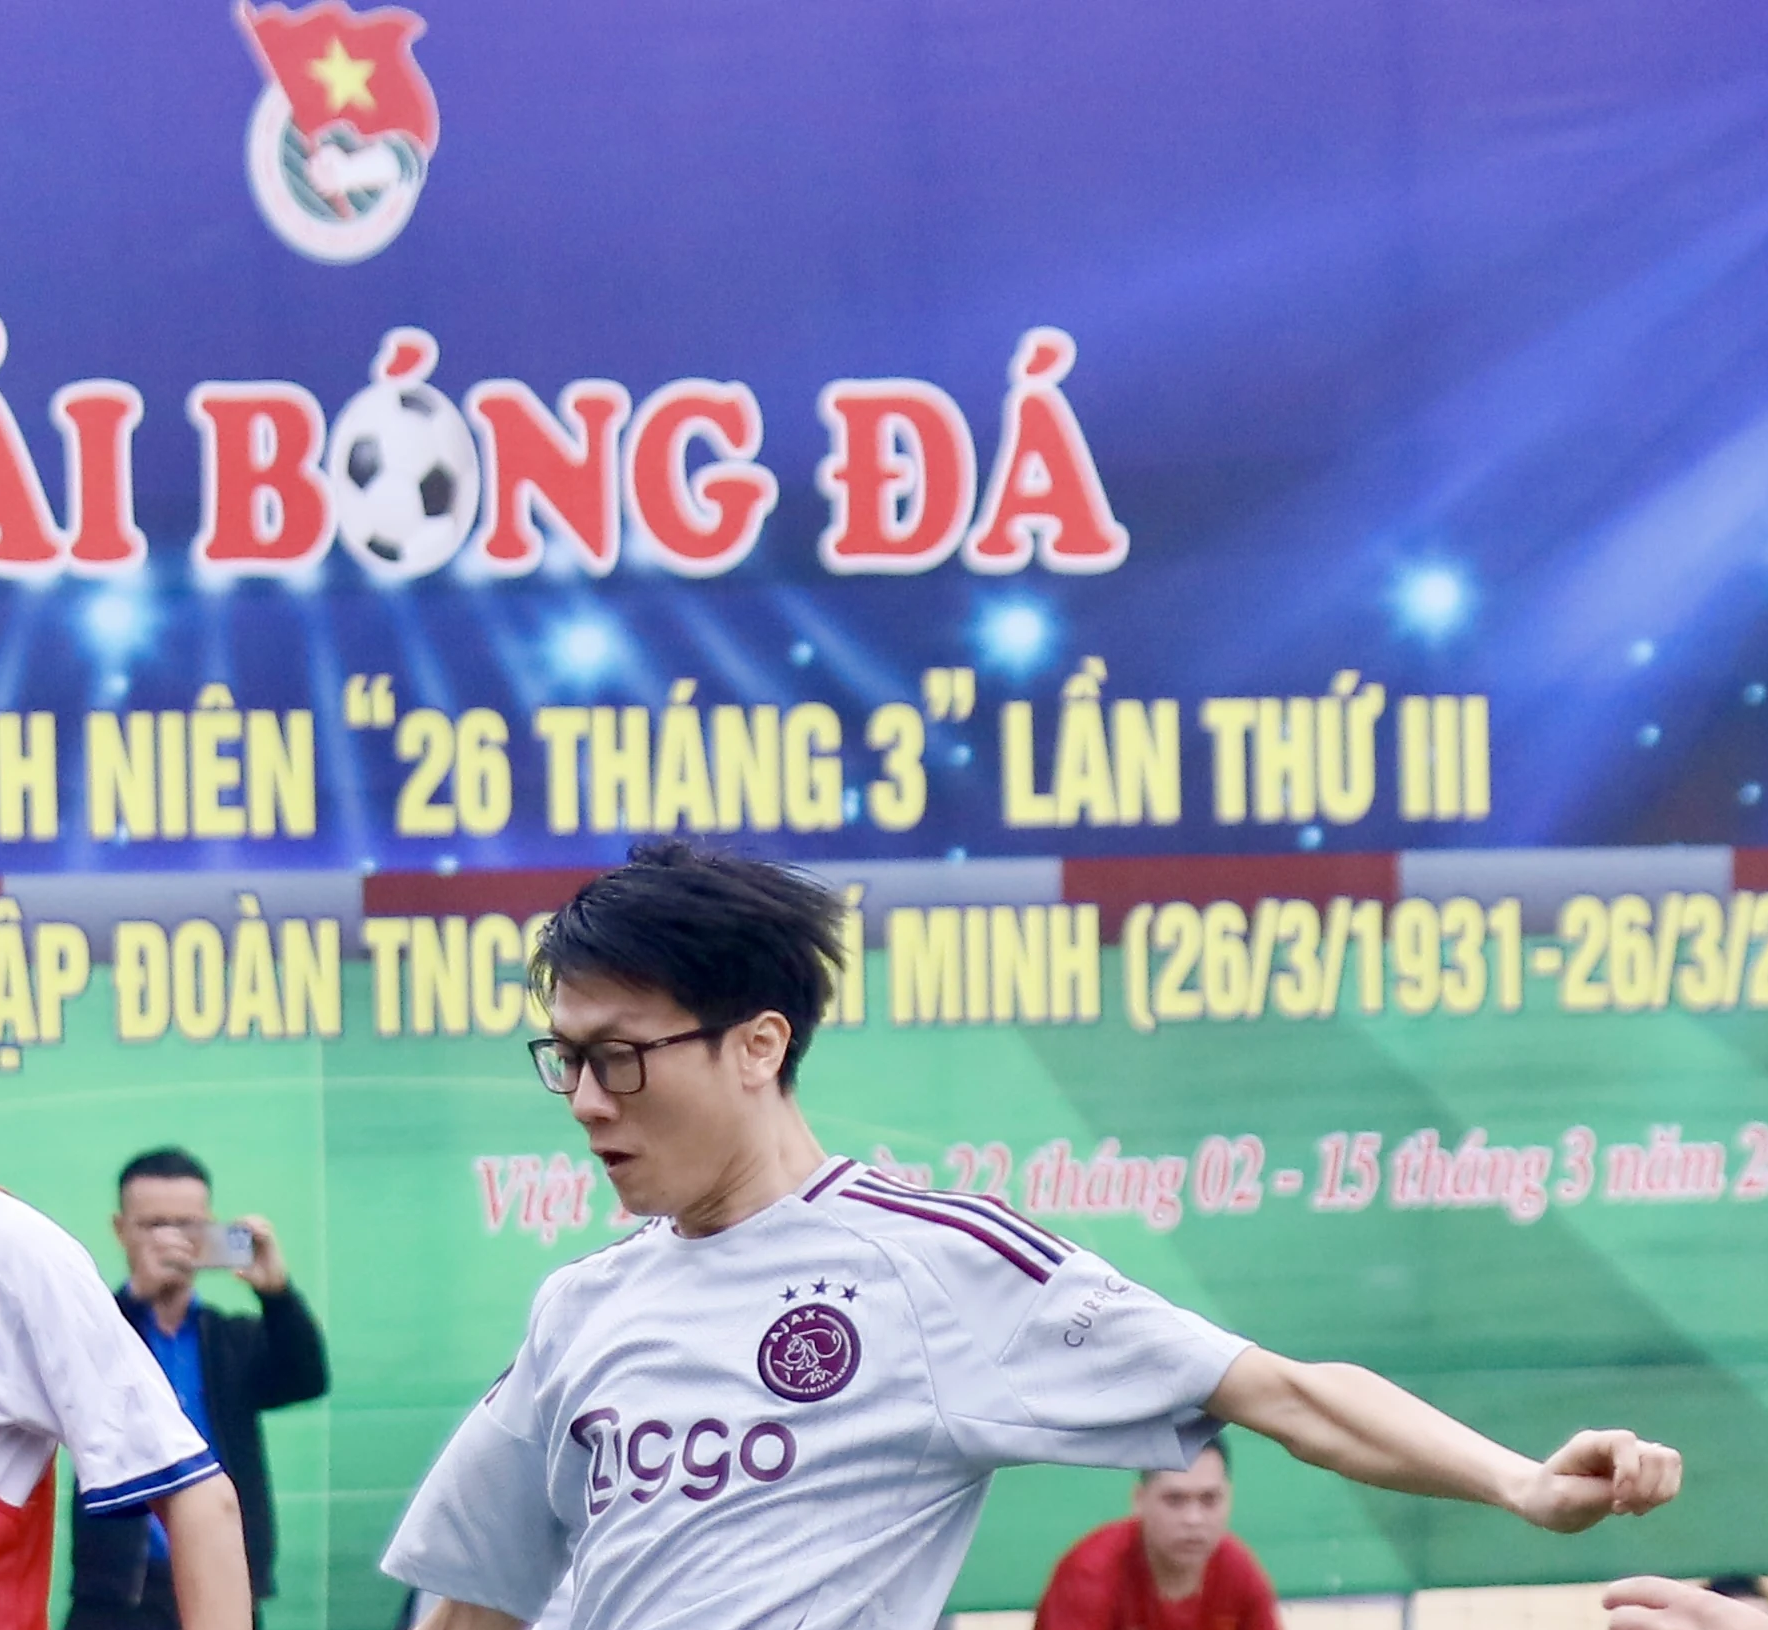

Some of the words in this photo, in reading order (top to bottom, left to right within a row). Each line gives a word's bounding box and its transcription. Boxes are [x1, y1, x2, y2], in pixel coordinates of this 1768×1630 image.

[187, 325, 780, 580] BÓNG
[819, 325, 1131, 575] ĐÁ
[86, 682, 317, 840] NIÊN
[535, 678, 844, 836] THÁNG
[999, 655, 1183, 828] LẦN
[1199, 668, 1386, 825] THỨ
[1396, 693, 1491, 823] III
[114, 892, 344, 1043] ĐOÀN
[889, 902, 1101, 1024] MINH
[474, 1152, 597, 1246] Việt
[1026, 1137, 1187, 1234] tháng
[1194, 1134, 1265, 1214] 02
[1314, 1131, 1382, 1212] 15
[1391, 1128, 1555, 1225] tháng
[1554, 1124, 1598, 1206] 3
[1604, 1122, 1729, 1205] năm
[771, 1309, 817, 1343] AJAX
